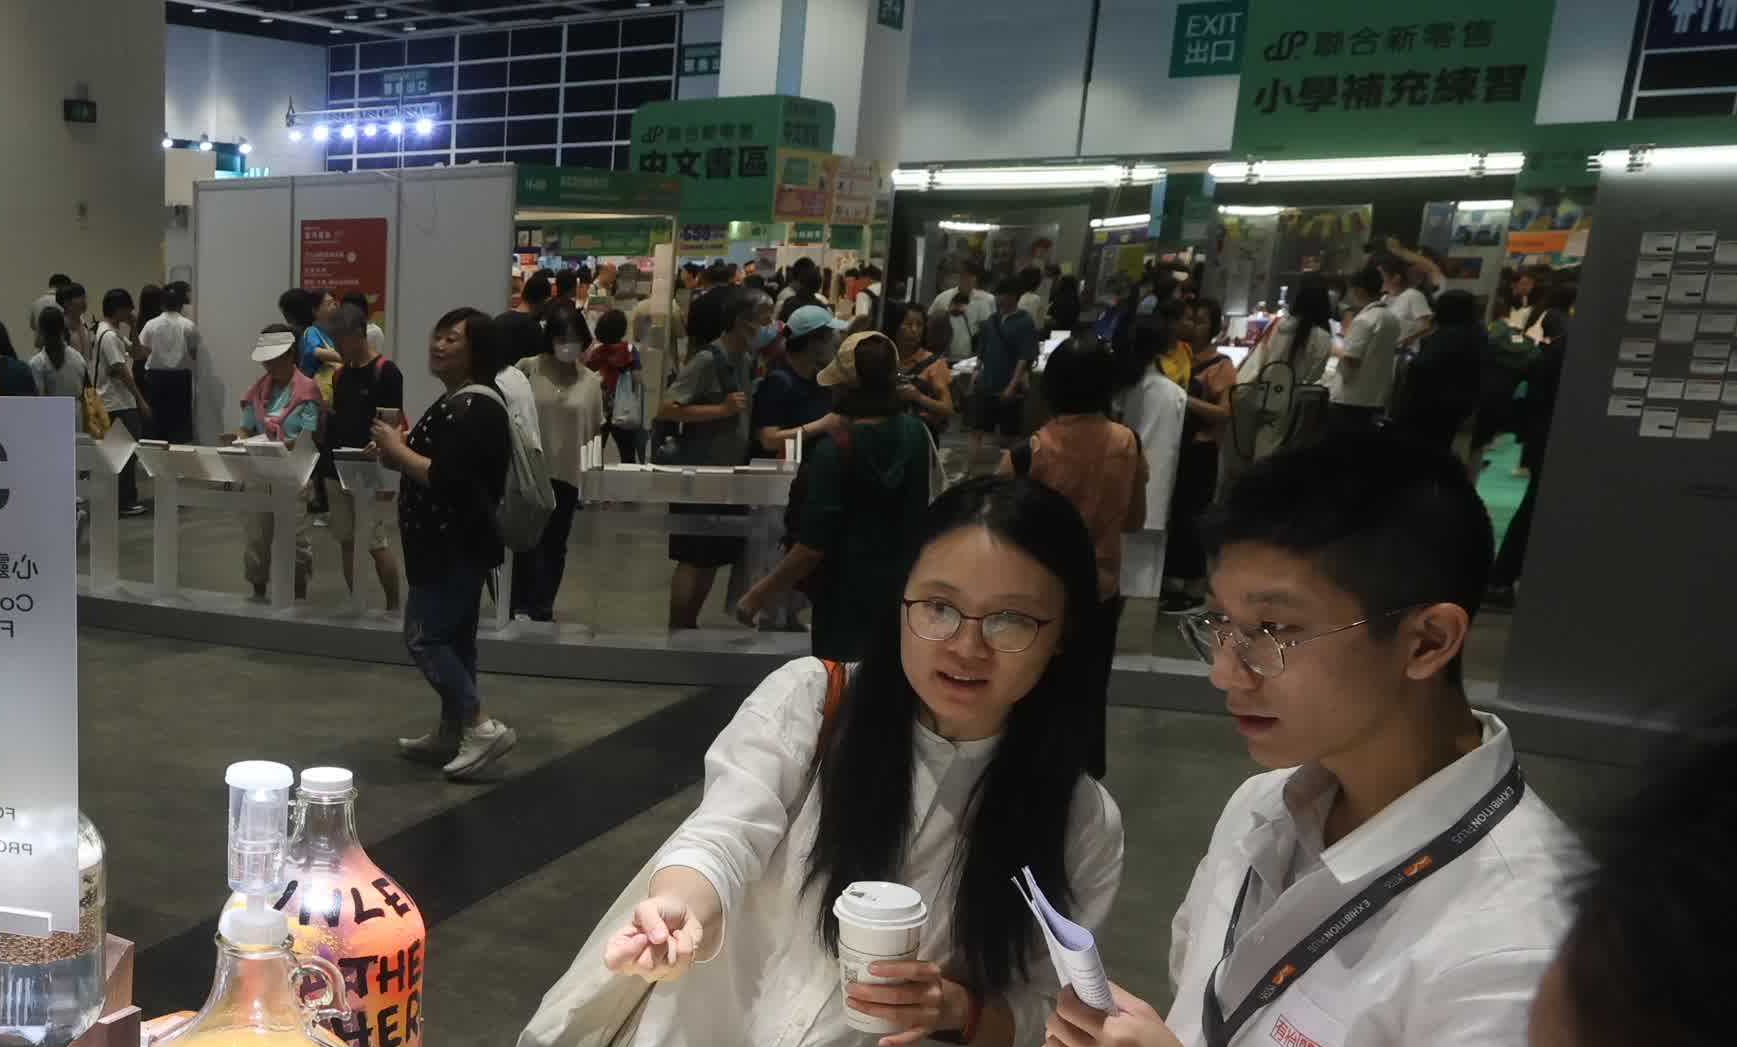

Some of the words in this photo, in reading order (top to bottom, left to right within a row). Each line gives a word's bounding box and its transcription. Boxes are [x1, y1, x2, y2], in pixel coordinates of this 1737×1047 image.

[1185, 12, 1243, 36] EXIT
[1185, 39, 1236, 65] 出口
[1254, 64, 1528, 116] 小學補充練習
[640, 146, 769, 180] 中文書區
